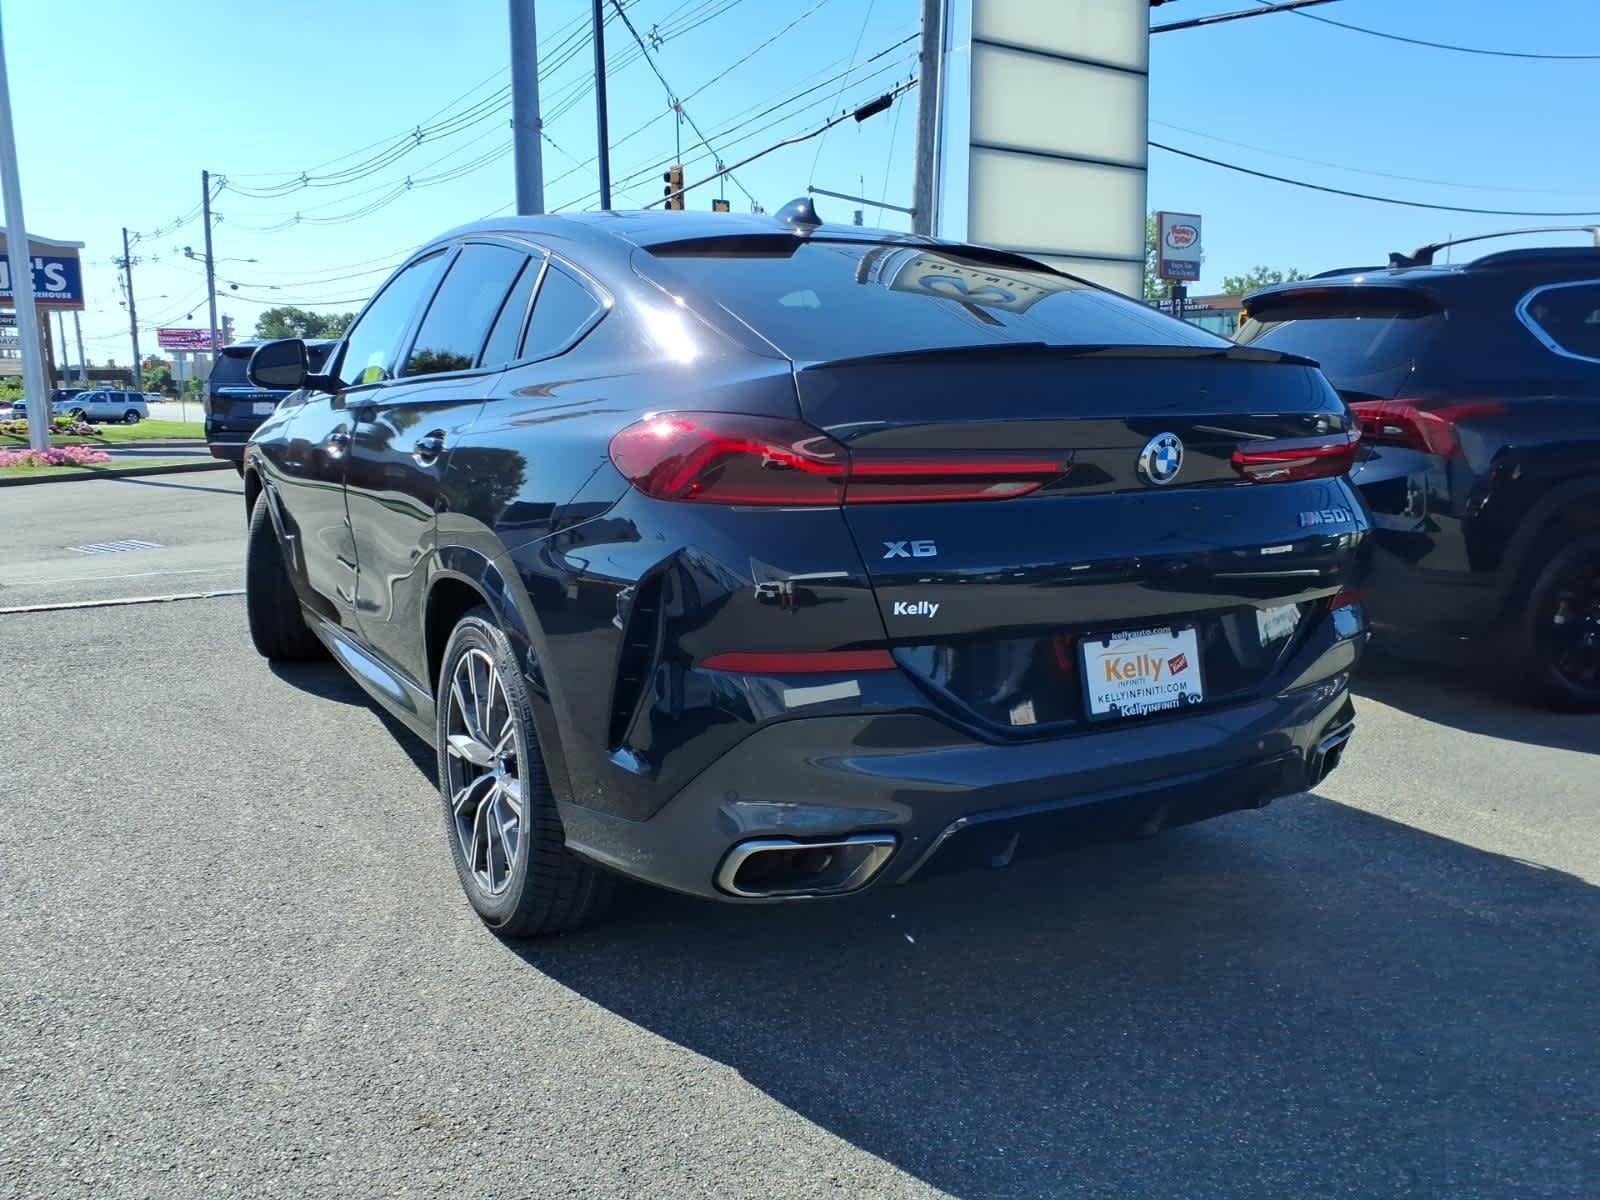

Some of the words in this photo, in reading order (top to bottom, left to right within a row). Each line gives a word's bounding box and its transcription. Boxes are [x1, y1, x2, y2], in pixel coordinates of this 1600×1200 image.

[882, 540, 937, 559] X6
[893, 601, 940, 618] Kelly
[1104, 655, 1162, 682] Kelly
[1098, 681, 1188, 704] KELLYINFINITI.COM
